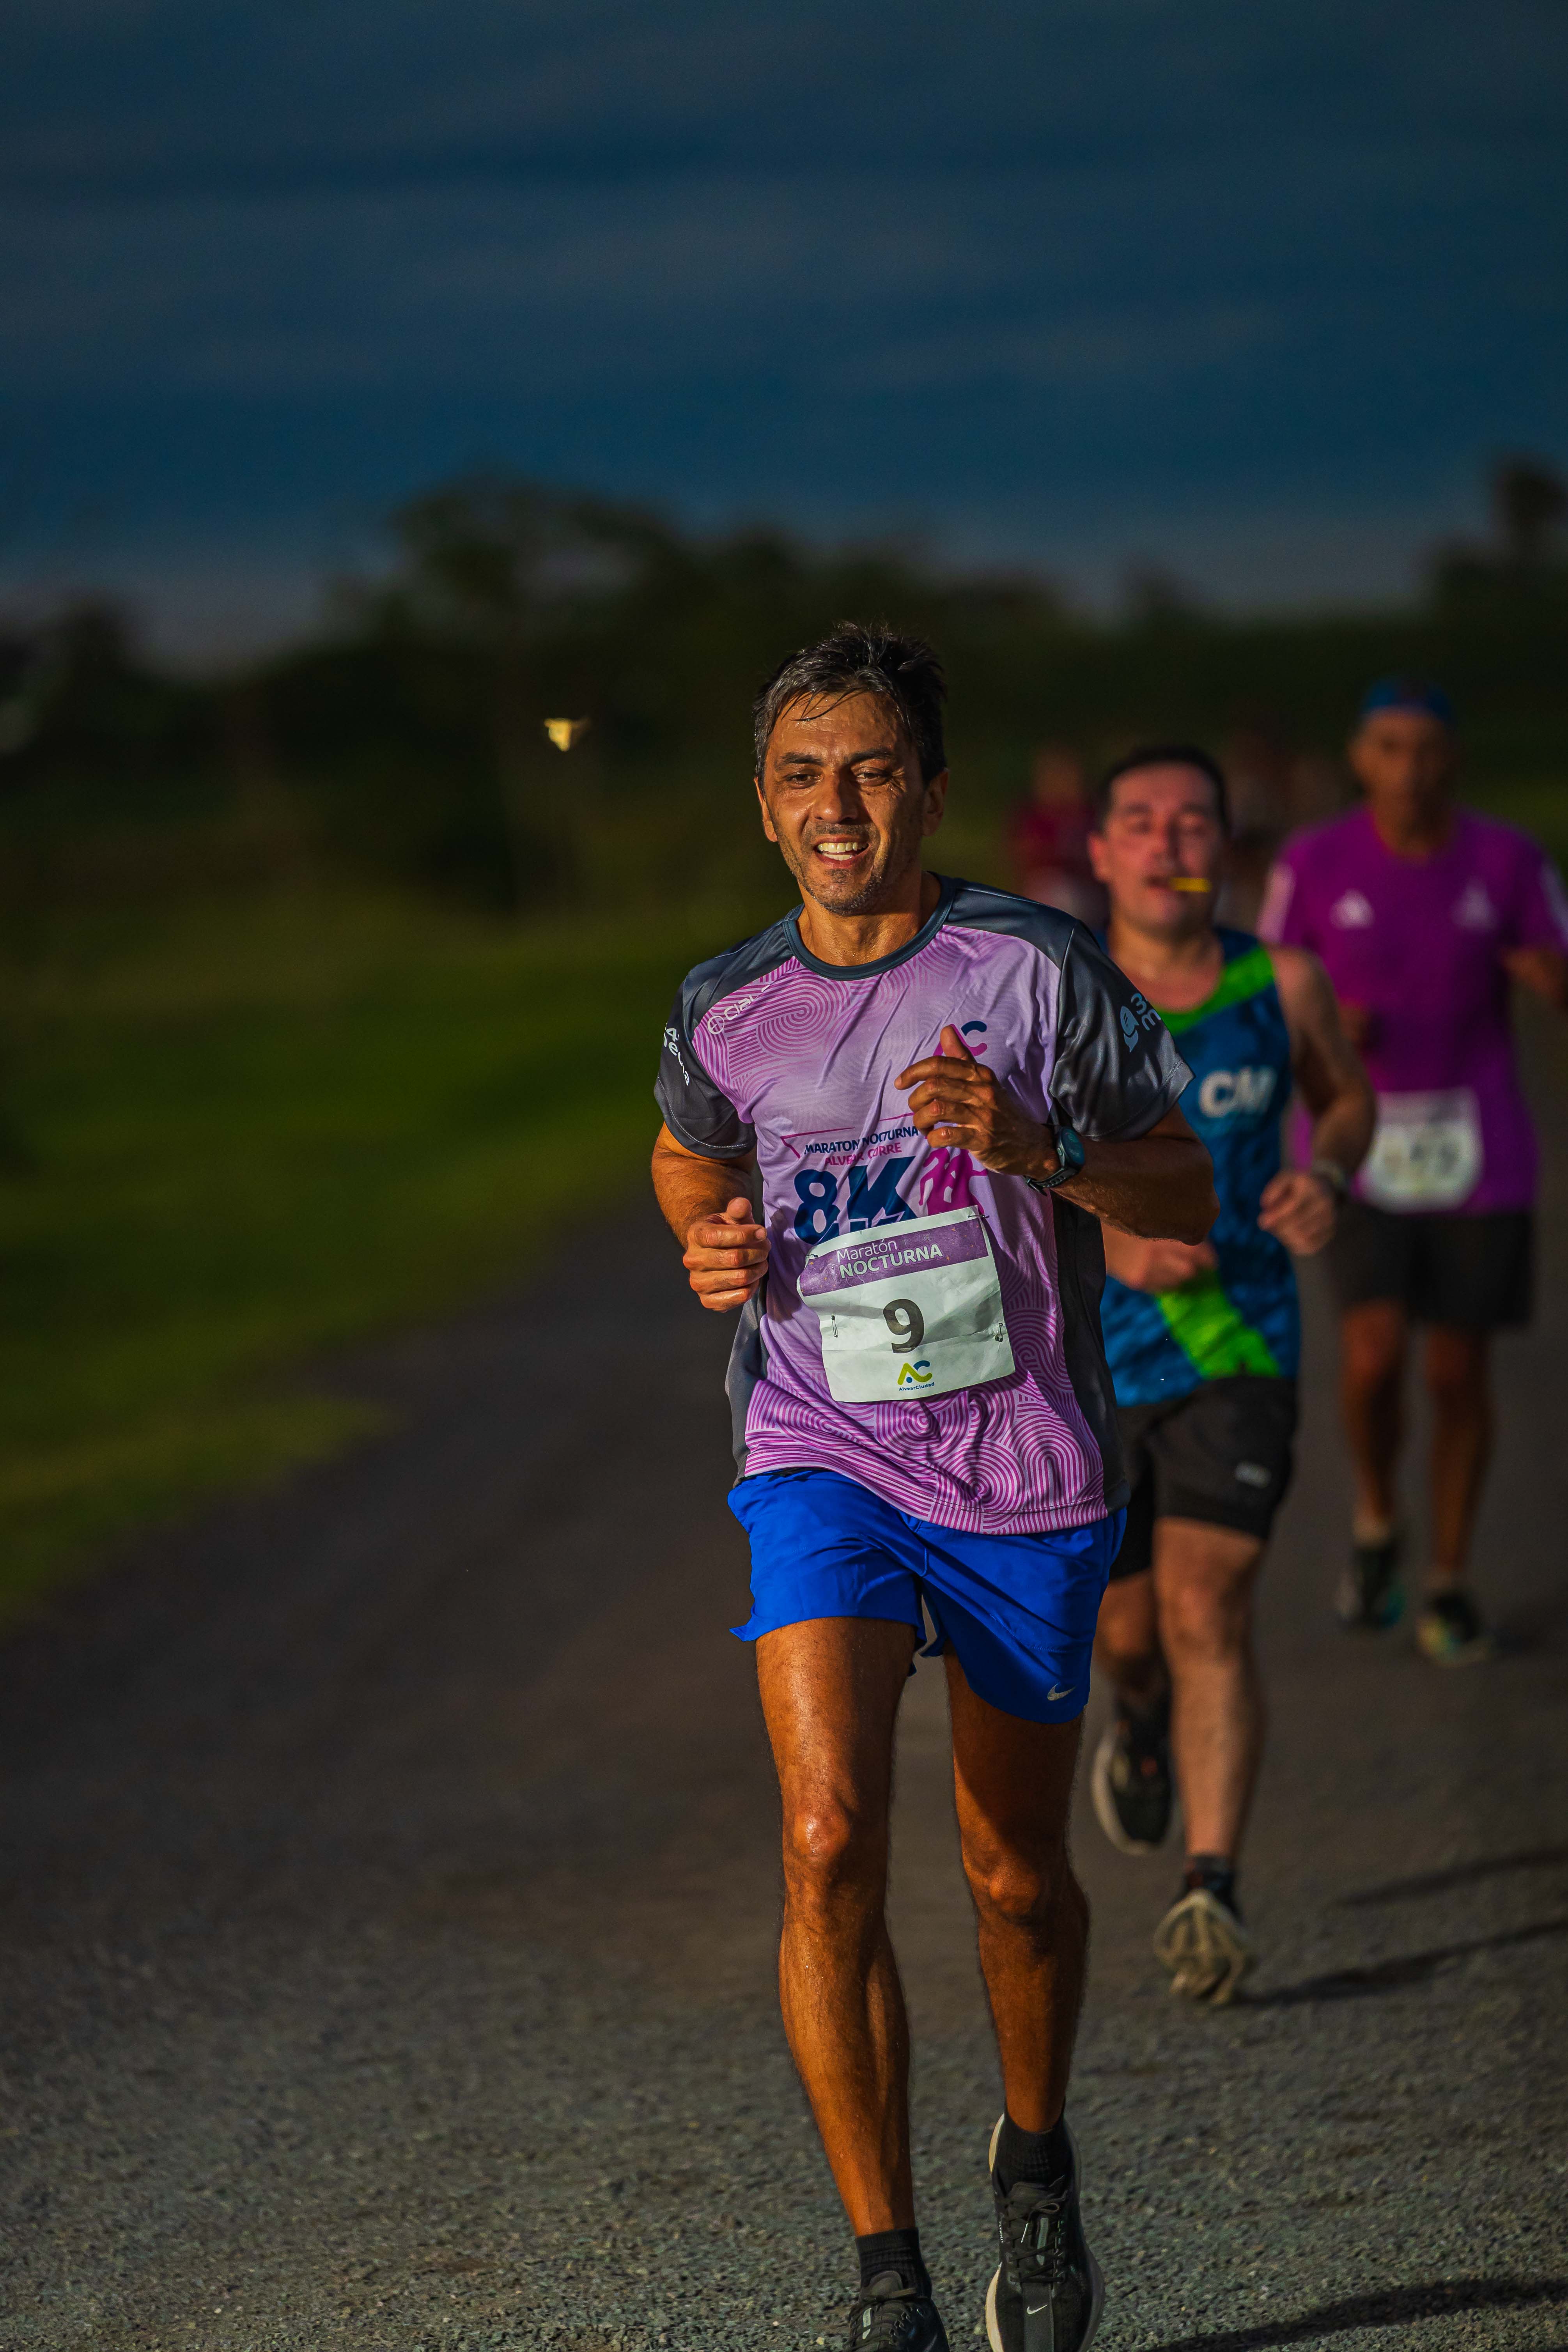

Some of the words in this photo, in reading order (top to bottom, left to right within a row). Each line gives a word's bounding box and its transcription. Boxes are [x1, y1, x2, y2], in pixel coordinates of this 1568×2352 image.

[804, 1139, 859, 1155] MARATON
[824, 1151, 865, 1165] ALVEAR
[794, 1156, 918, 1245] 8K
[837, 1238, 897, 1263] Maratón
[839, 1243, 943, 1279] NOCTURNA
[882, 1298, 925, 1353] 9
[899, 1381, 935, 1391] AlvearCiudad
